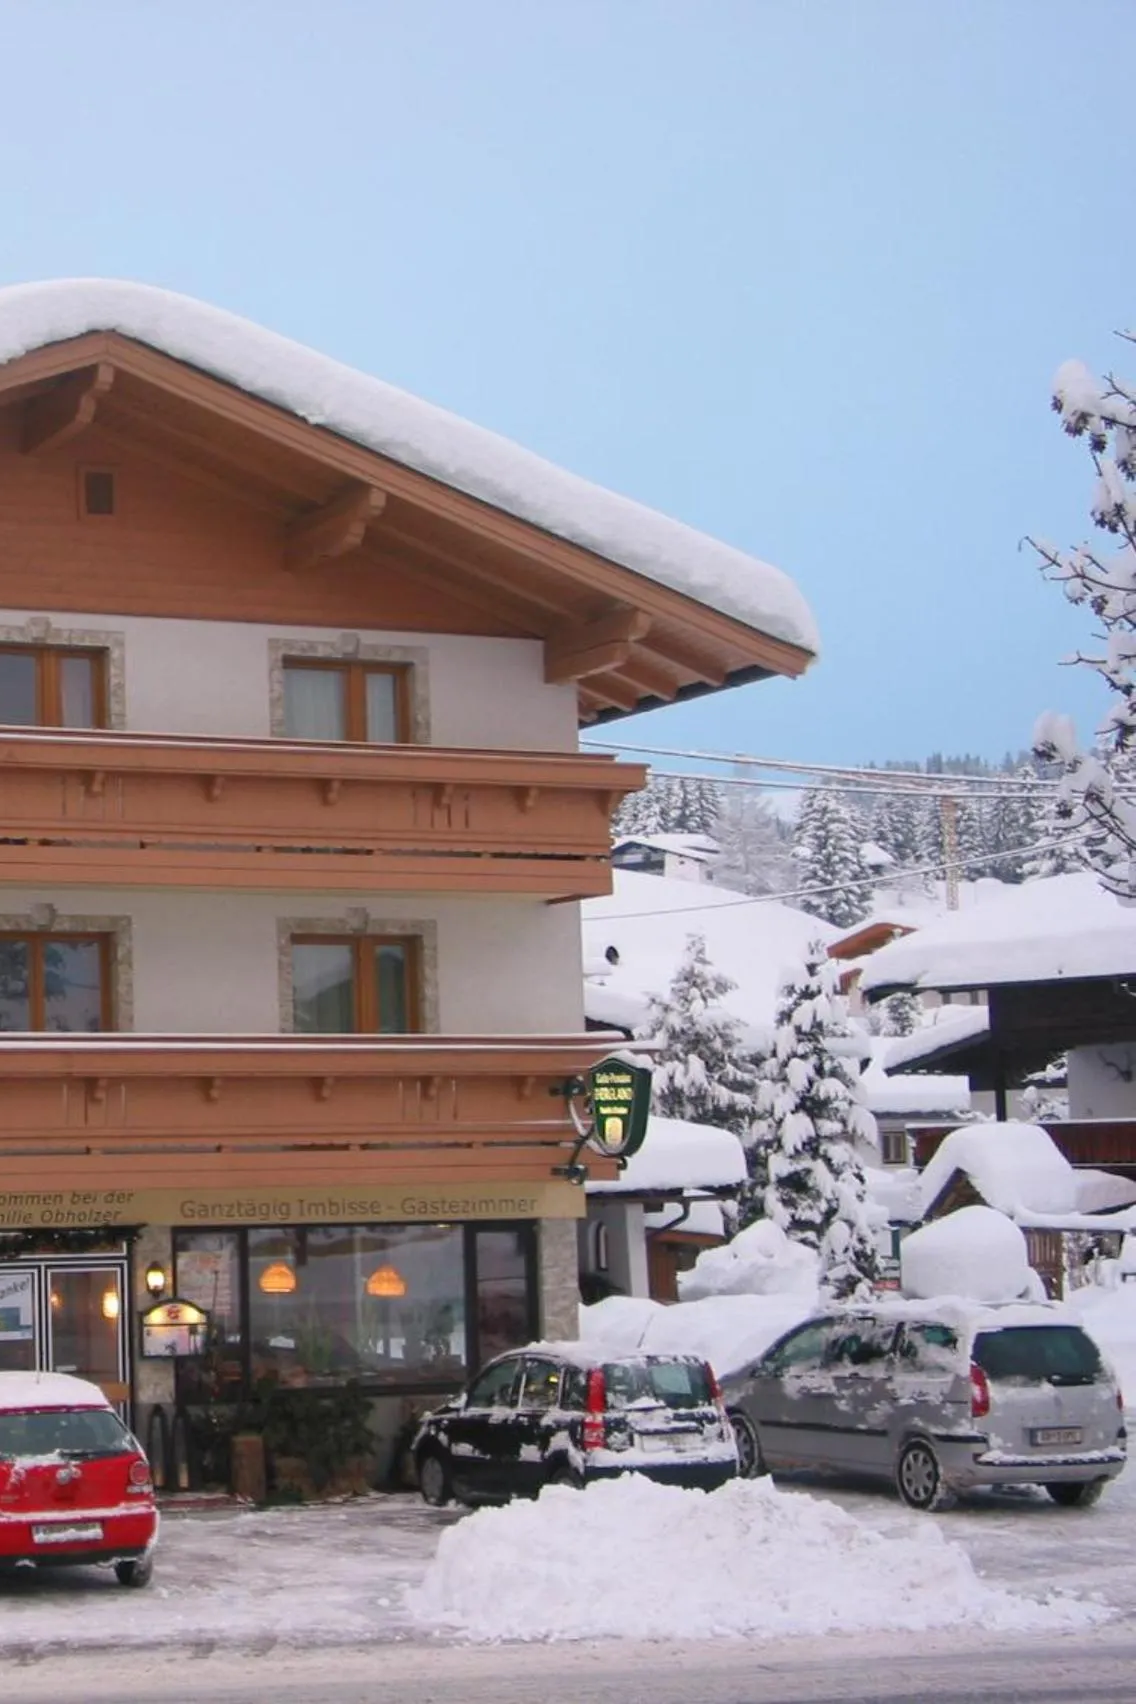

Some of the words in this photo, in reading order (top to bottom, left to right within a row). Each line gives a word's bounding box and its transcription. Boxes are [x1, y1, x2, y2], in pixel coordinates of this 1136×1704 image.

[70, 1191, 98, 1206] bei
[103, 1190, 135, 1205] der
[40, 1209, 122, 1224] Obholzer
[179, 1198, 292, 1220] Ganztägig
[298, 1197, 382, 1216] Imbisse
